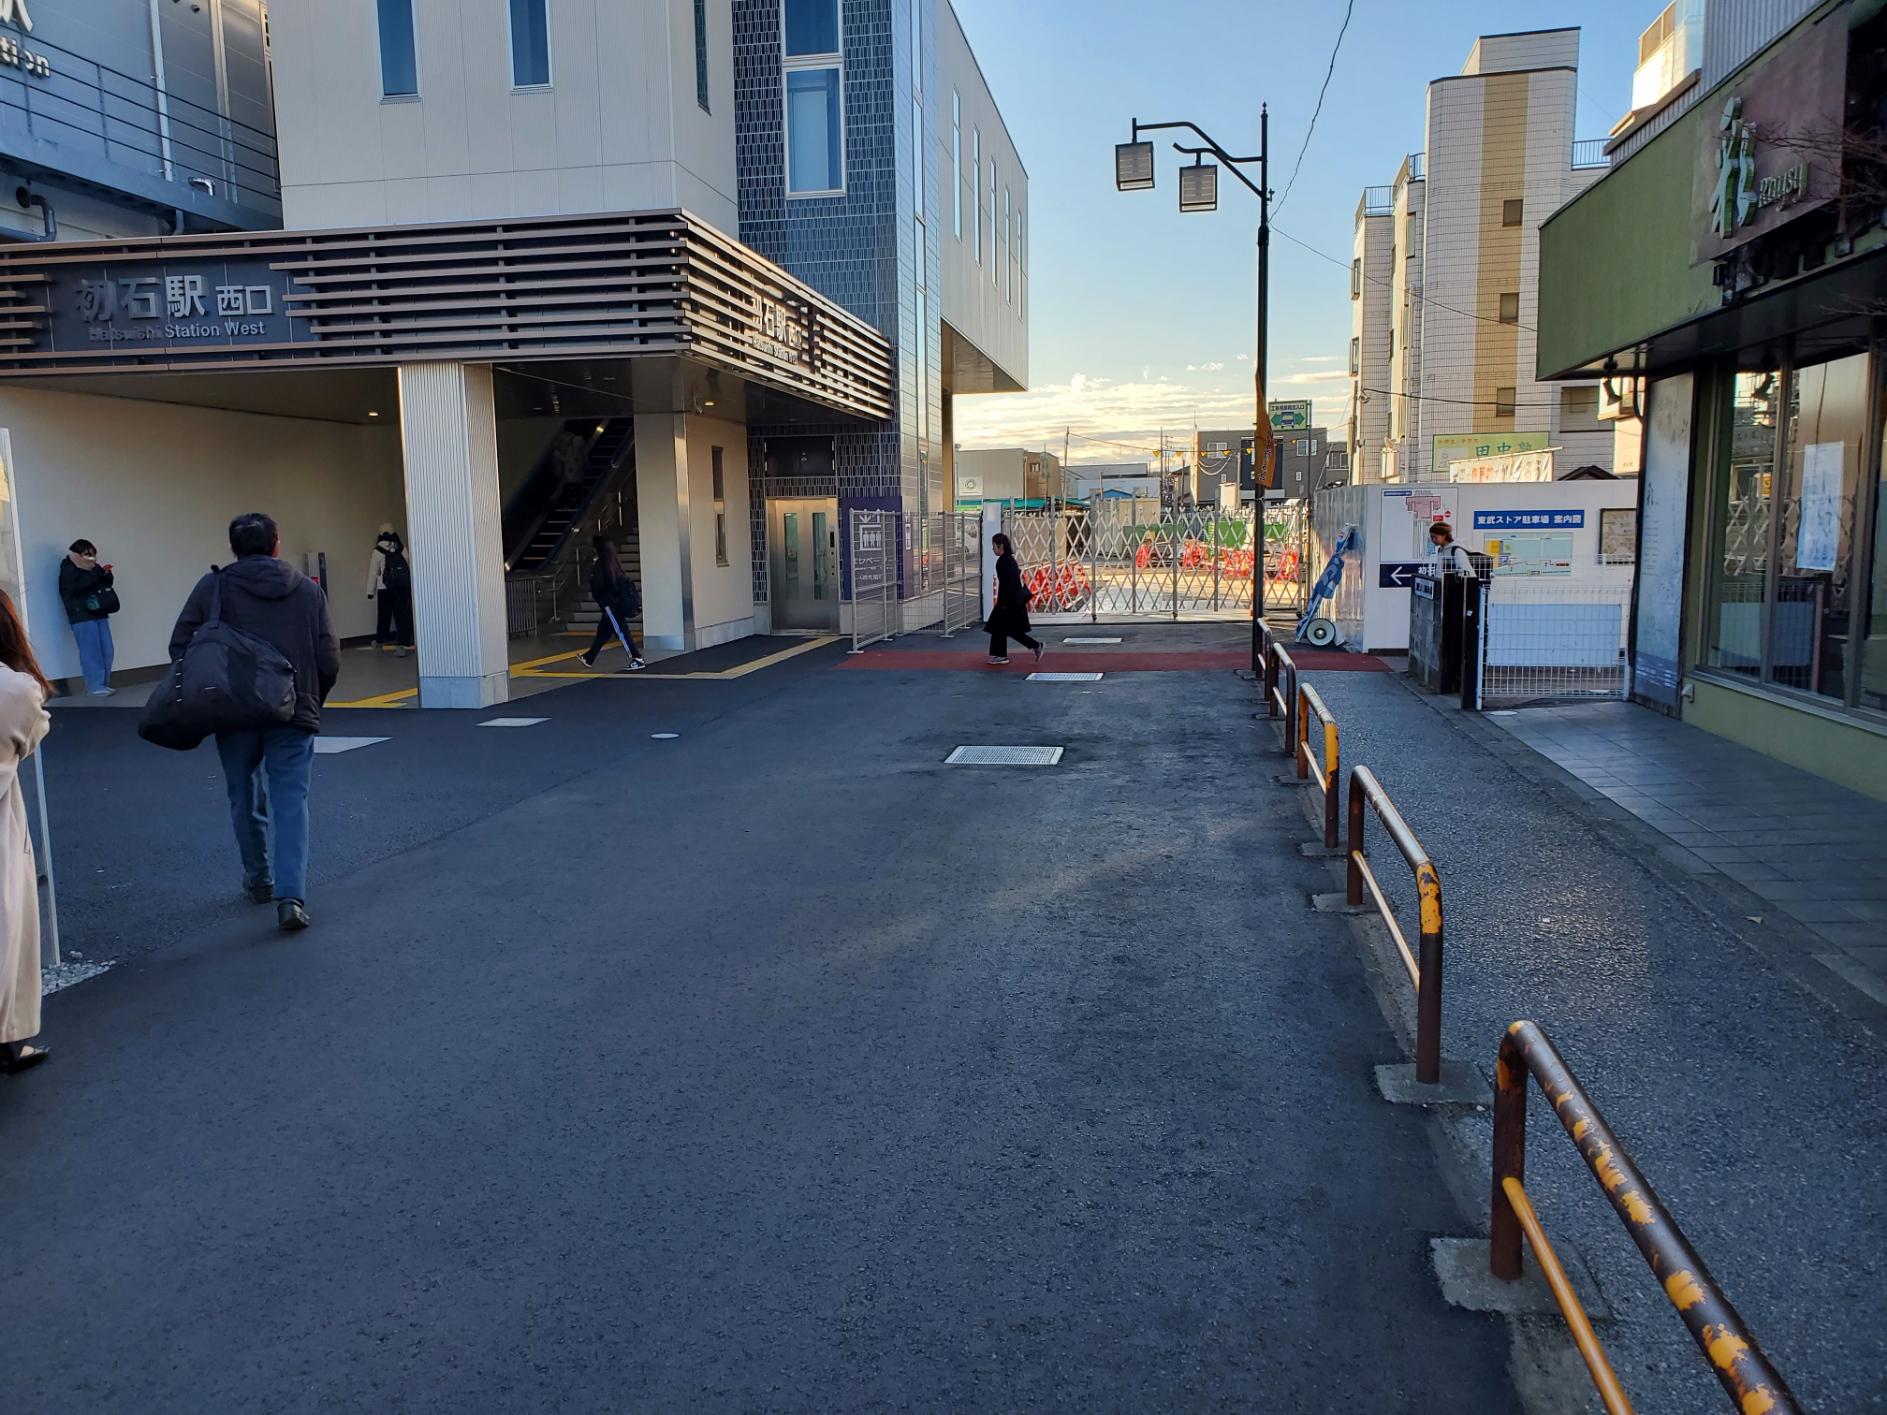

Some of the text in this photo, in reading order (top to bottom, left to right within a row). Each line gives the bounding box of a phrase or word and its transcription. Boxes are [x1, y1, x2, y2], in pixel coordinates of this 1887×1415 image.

[215, 285, 275, 316] 西口
[165, 322, 220, 338] Station
[225, 321, 266, 336] West
